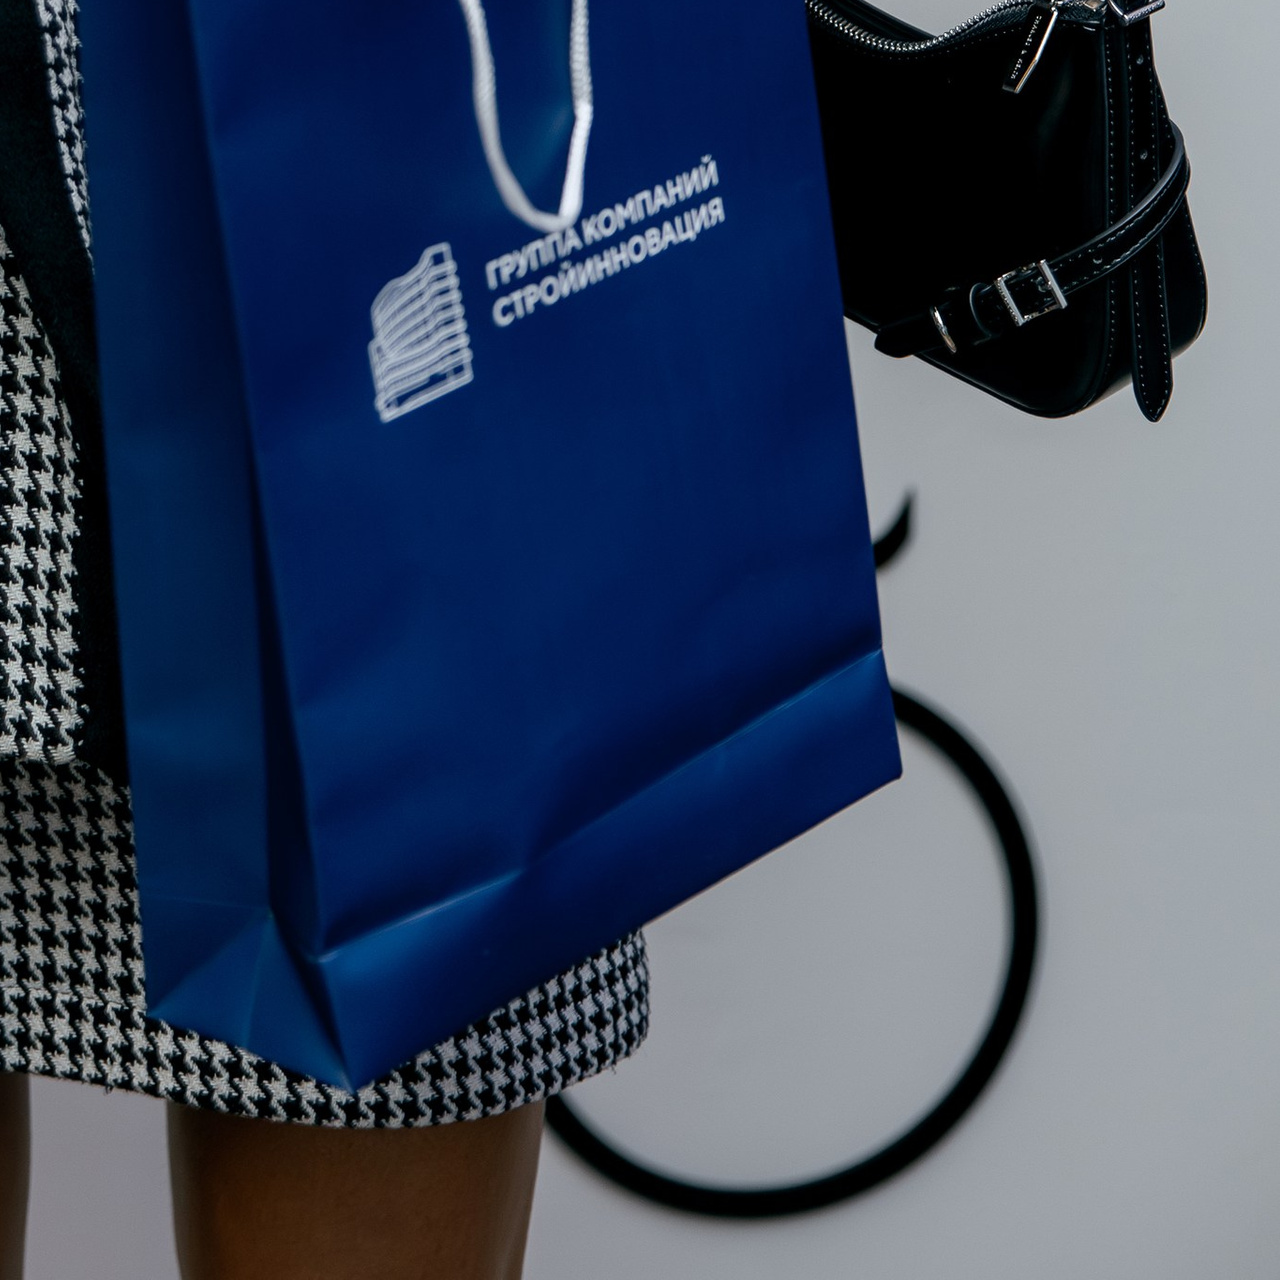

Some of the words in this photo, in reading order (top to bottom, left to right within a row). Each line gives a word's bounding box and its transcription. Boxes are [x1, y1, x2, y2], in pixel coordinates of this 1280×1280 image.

[485, 226, 583, 290] ГРУППА
[581, 154, 720, 246] КОМПАНИЙ
[492, 196, 725, 328] СТРОЙИННОВАЦИЯ
